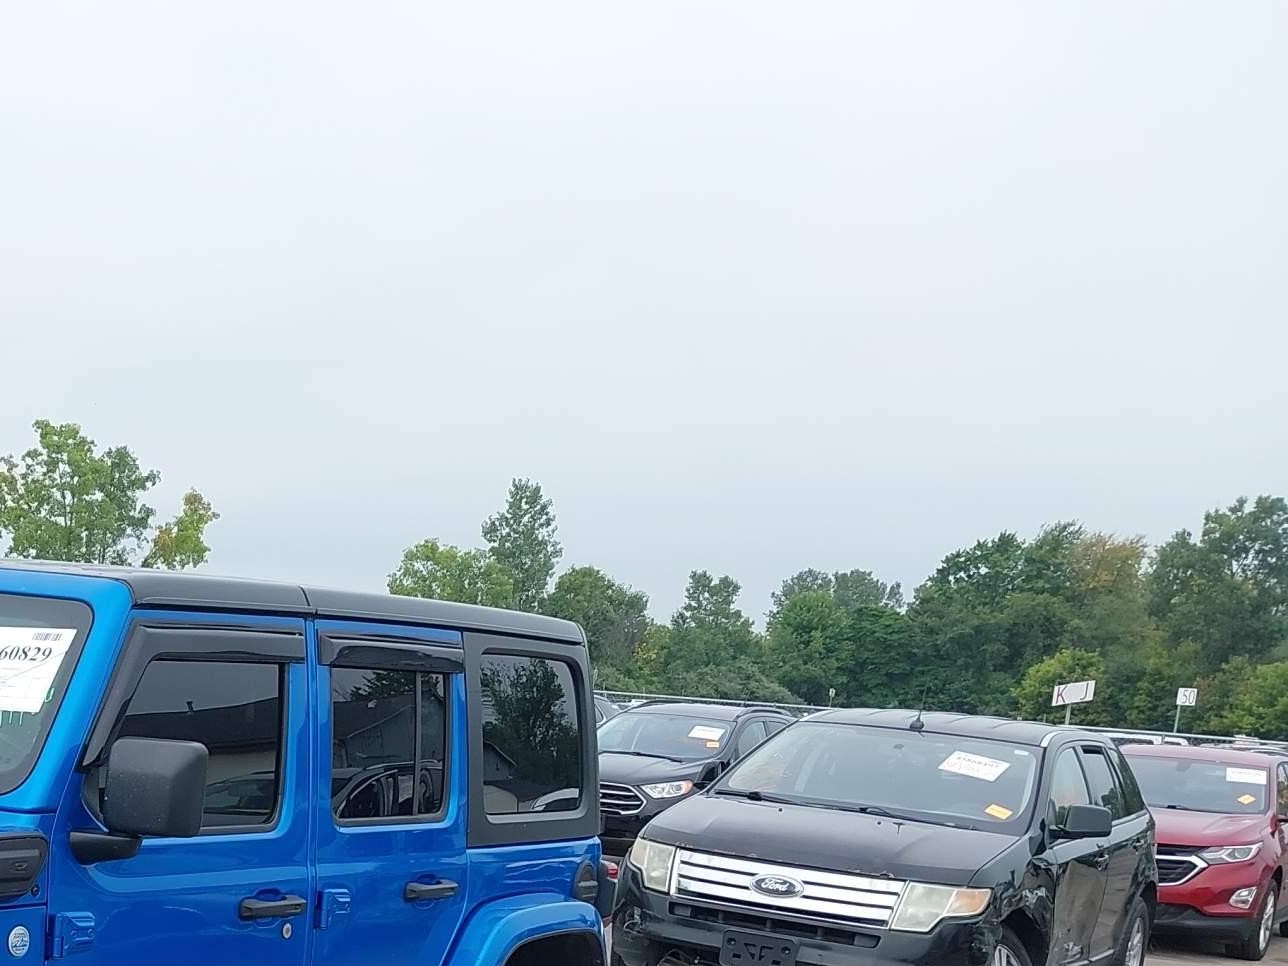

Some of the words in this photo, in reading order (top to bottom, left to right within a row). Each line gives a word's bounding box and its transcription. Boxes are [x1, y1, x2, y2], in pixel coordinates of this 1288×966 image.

[1055, 685, 1067, 704] K
[1079, 682, 1089, 701] J
[1181, 689, 1196, 705] 50
[760, 876, 789, 892] Ford
